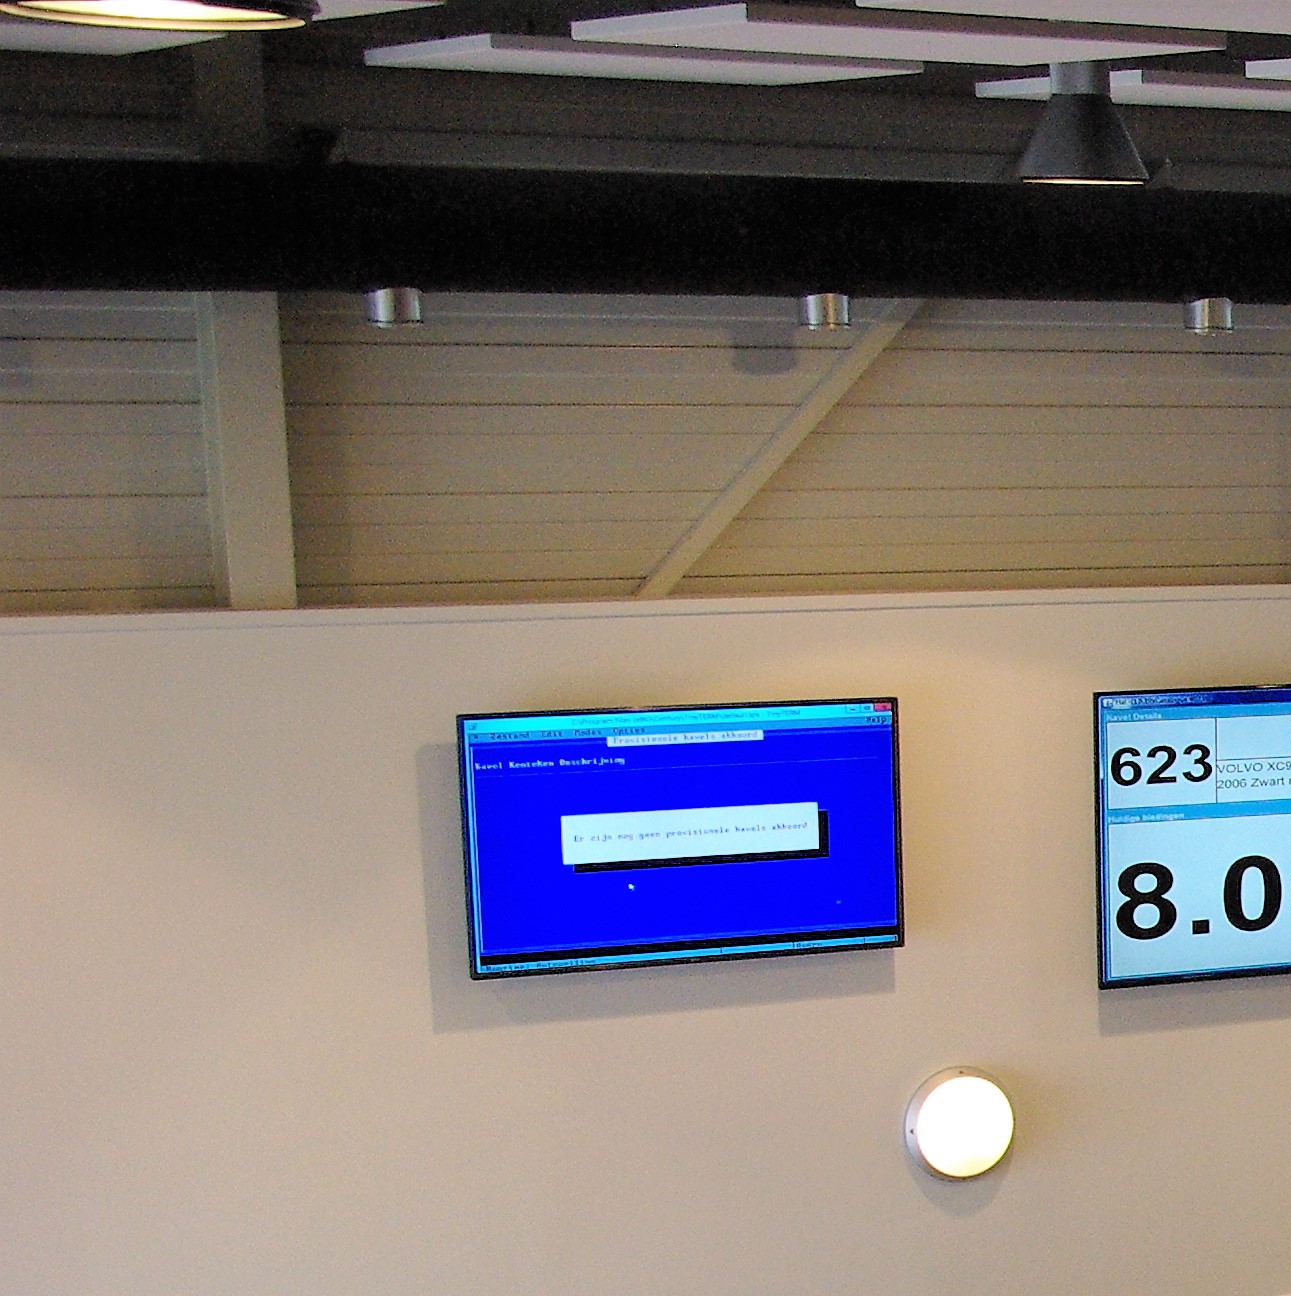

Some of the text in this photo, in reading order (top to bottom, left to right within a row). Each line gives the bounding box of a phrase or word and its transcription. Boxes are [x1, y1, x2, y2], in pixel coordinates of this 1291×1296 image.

[475, 762, 503, 770] Kavel
[1110, 744, 1213, 786] 623
[1217, 762, 1263, 774] VOLVO
[1217, 778, 1247, 789] 2006
[1250, 776, 1285, 788] Zwart
